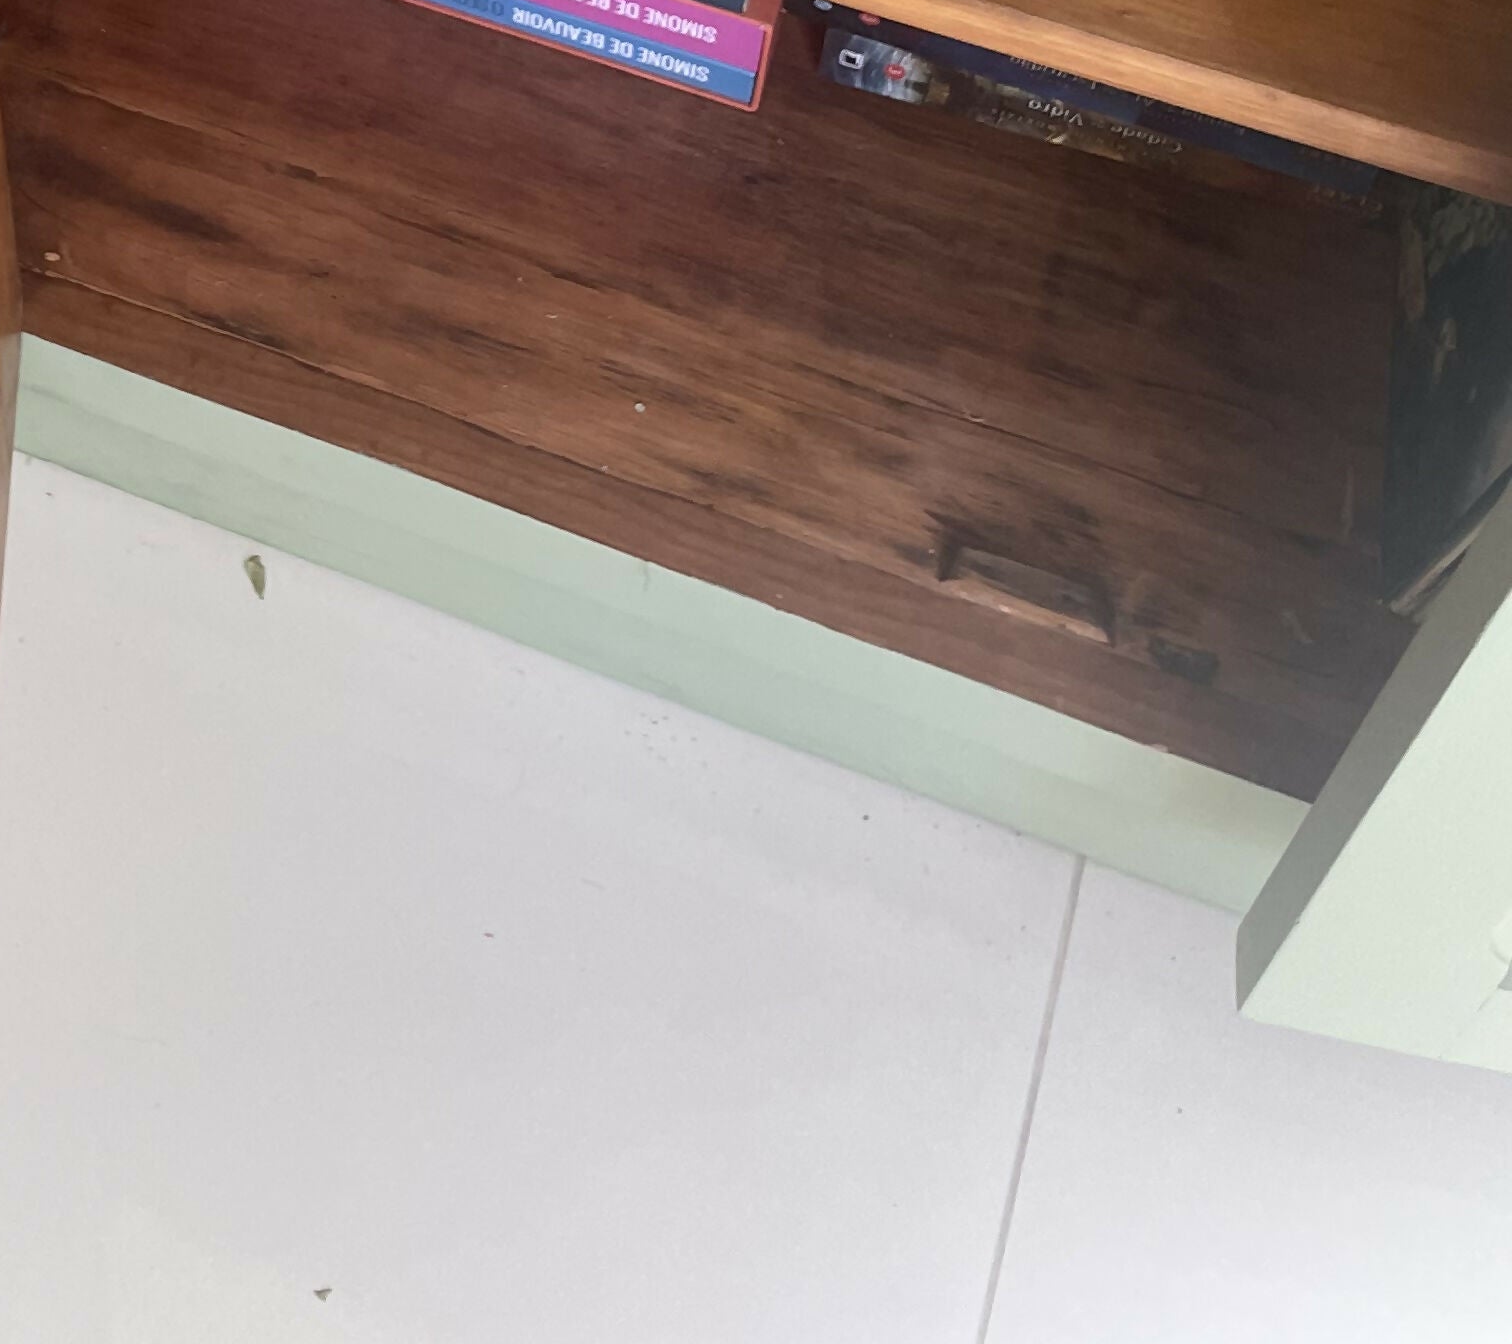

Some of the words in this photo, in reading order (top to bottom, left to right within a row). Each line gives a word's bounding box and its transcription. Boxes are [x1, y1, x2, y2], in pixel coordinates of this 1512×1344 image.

[511, 7, 605, 50] BEAUVOIR
[643, 6, 718, 44] SIMONE
[609, 37, 634, 59] DE
[638, 45, 710, 83] SIMONE
